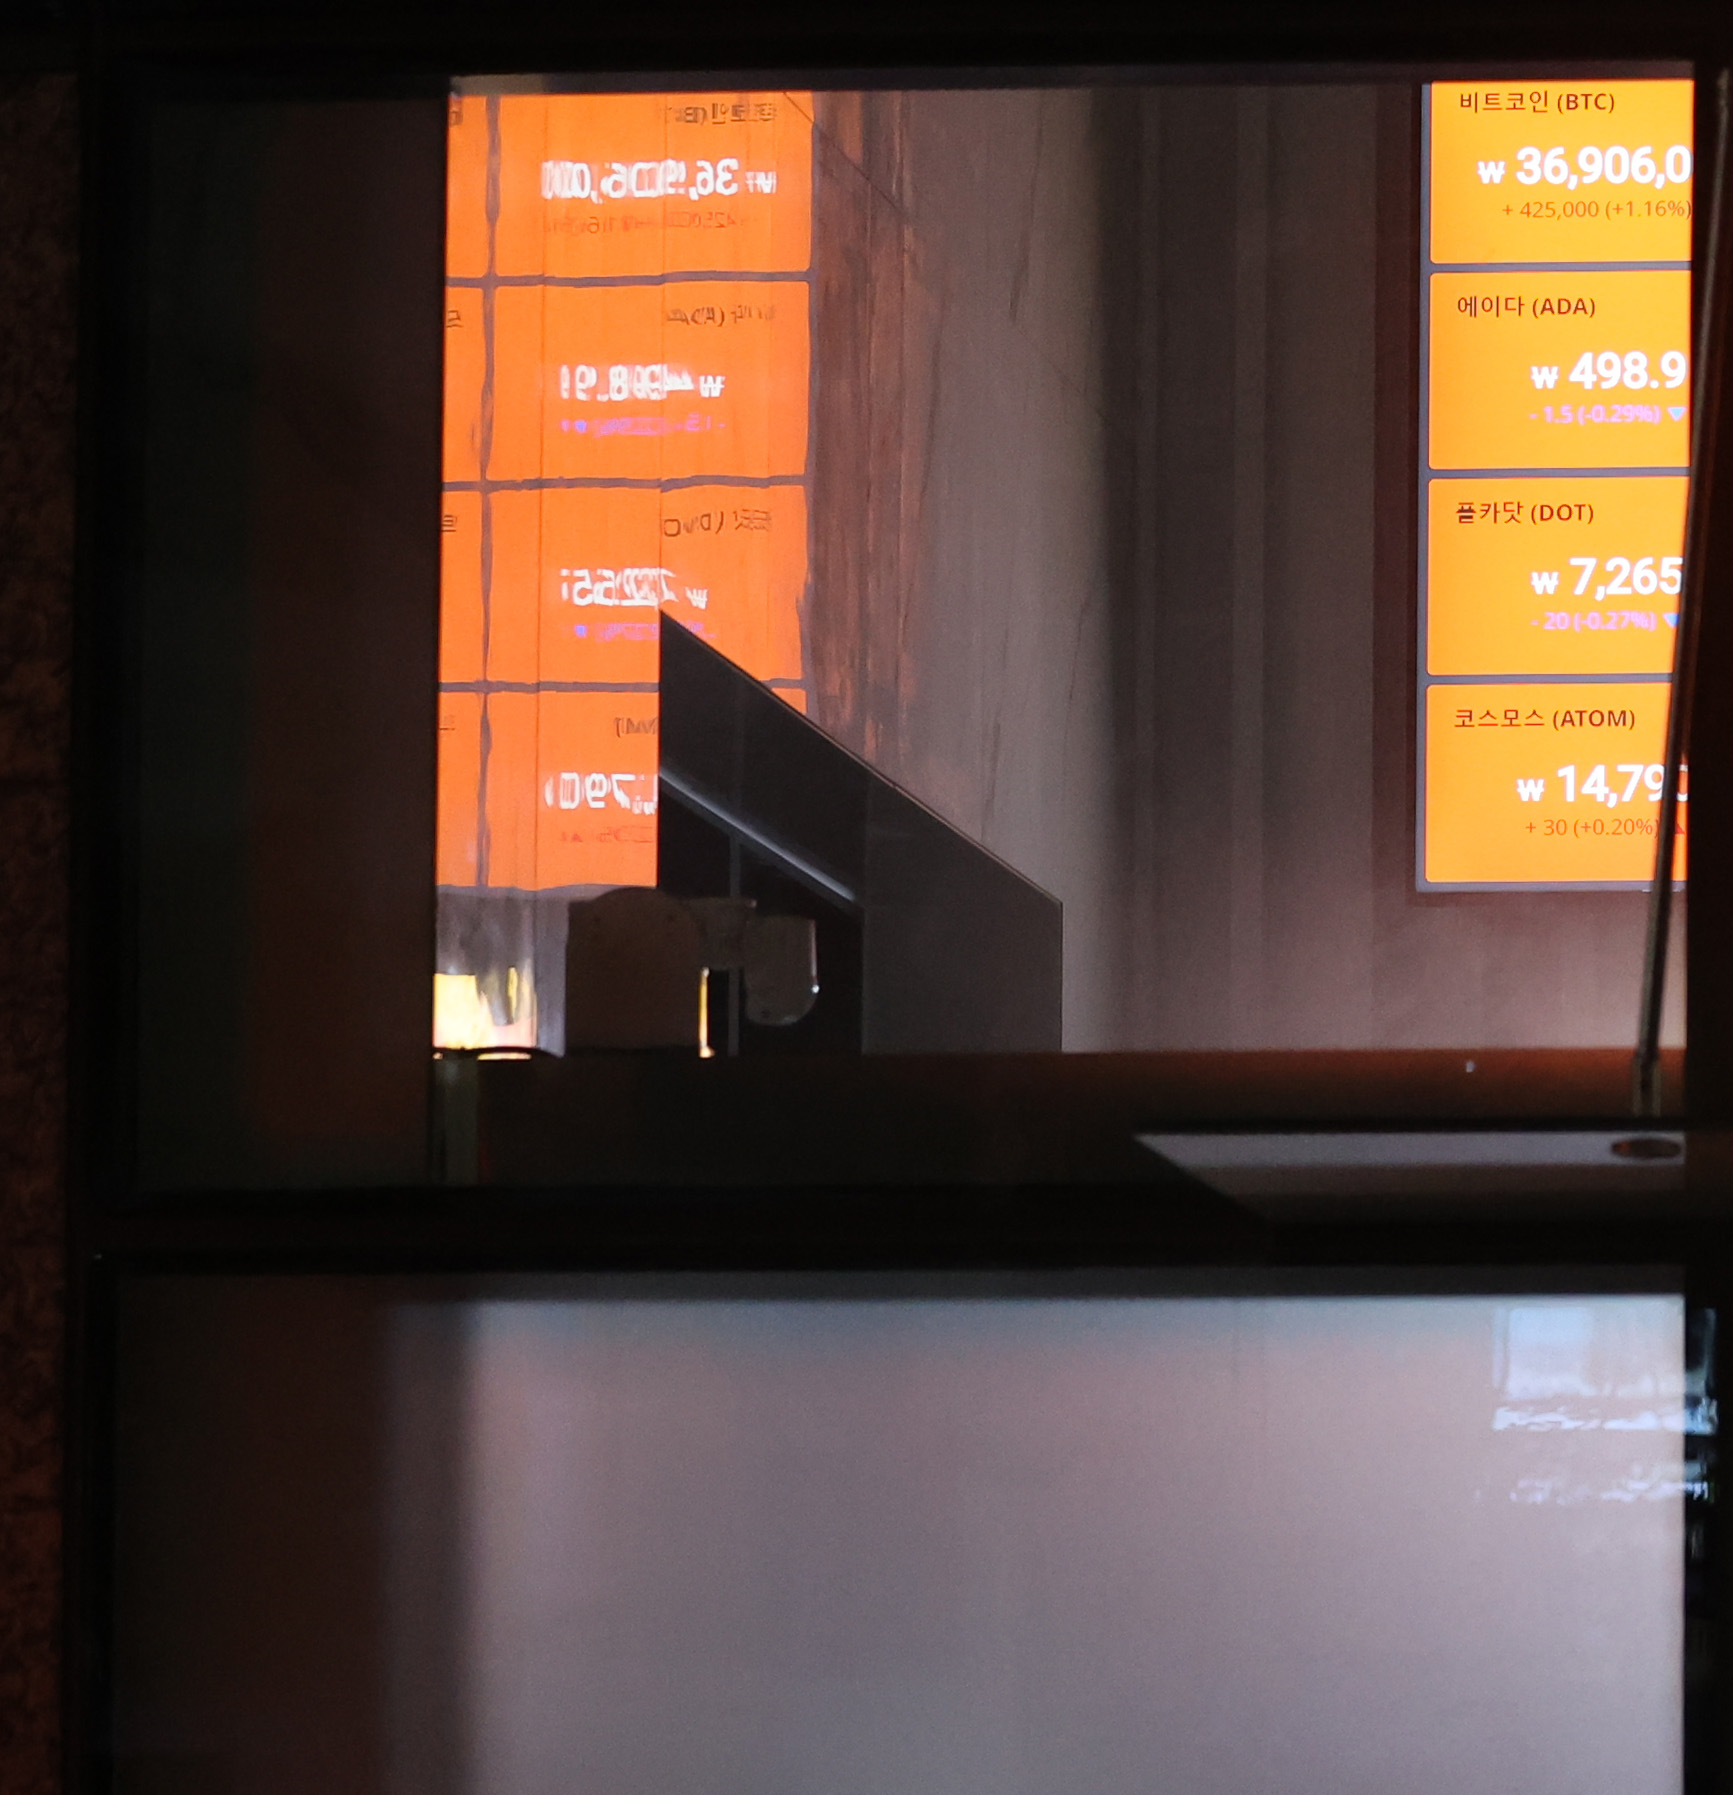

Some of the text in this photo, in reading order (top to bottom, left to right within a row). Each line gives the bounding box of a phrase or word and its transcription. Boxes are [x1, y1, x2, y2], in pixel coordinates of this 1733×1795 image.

[1459, 89, 1615, 115] 비트코인 (BTC)
[1519, 200, 1600, 221] 425,000
[1605, 197, 1692, 223] (+1.16%)
[1457, 295, 1596, 320] 에이다 (ADA)
[1568, 351, 1688, 389] 498.9
[1455, 500, 1594, 526] 폴카닷 (DOT)
[1454, 708, 1635, 732] 코스모스 (ATOM)
[1543, 818, 1568, 837] 30
